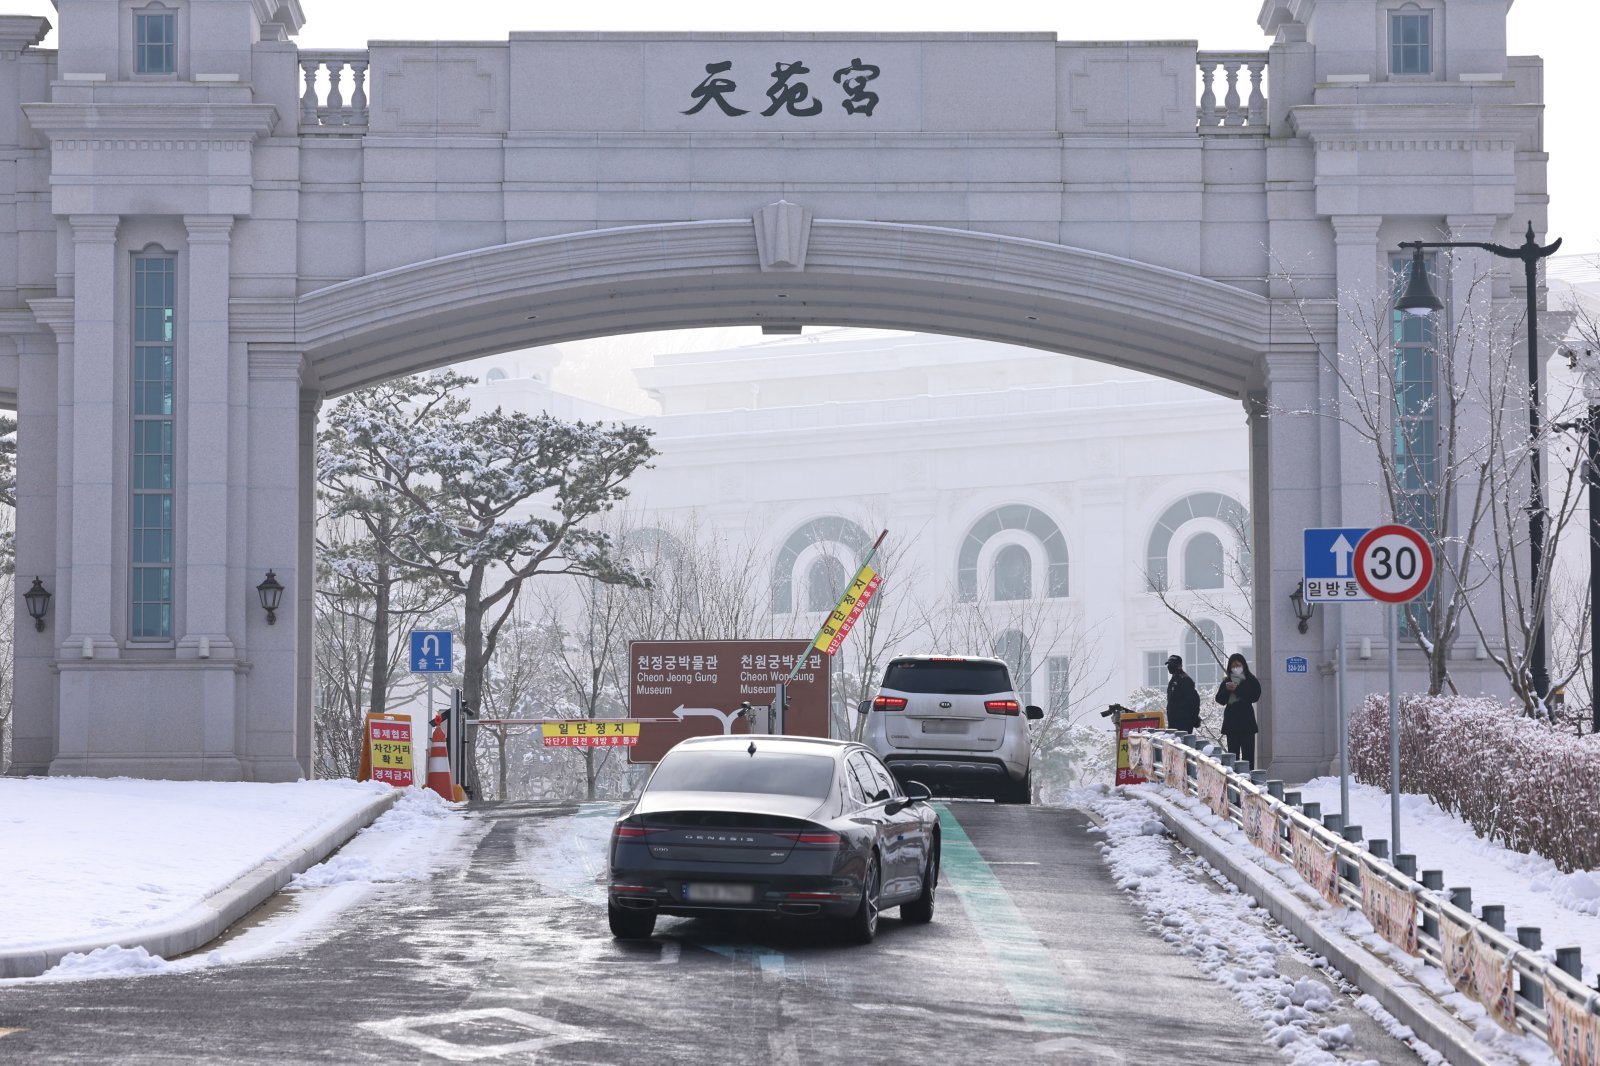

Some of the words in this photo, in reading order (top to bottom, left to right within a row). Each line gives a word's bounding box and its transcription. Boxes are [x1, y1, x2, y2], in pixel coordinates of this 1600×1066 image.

[678, 57, 881, 117] 天苑宮
[1371, 546, 1416, 580] 30
[1308, 581, 1359, 597] 일방통
[417, 658, 444, 669] 출구
[637, 654, 719, 670] 천정궁박물관
[637, 672, 664, 682] Cheon
[666, 672, 692, 684] Jeong
[695, 672, 718, 684] Gung
[740, 671, 767, 682] Cheon
[770, 671, 790, 681] Won
[637, 685, 672, 695] Museum
[740, 684, 776, 694] Museum
[372, 728, 410, 740] 통제협조
[545, 737, 569, 746] 차단기
[572, 737, 588, 746] 완전
[591, 737, 607, 746] 개방
[373, 743, 411, 755] 차간거리
[382, 754, 404, 765] 확보
[374, 769, 413, 781] 경적금지
[685, 834, 754, 842] GENESIS
